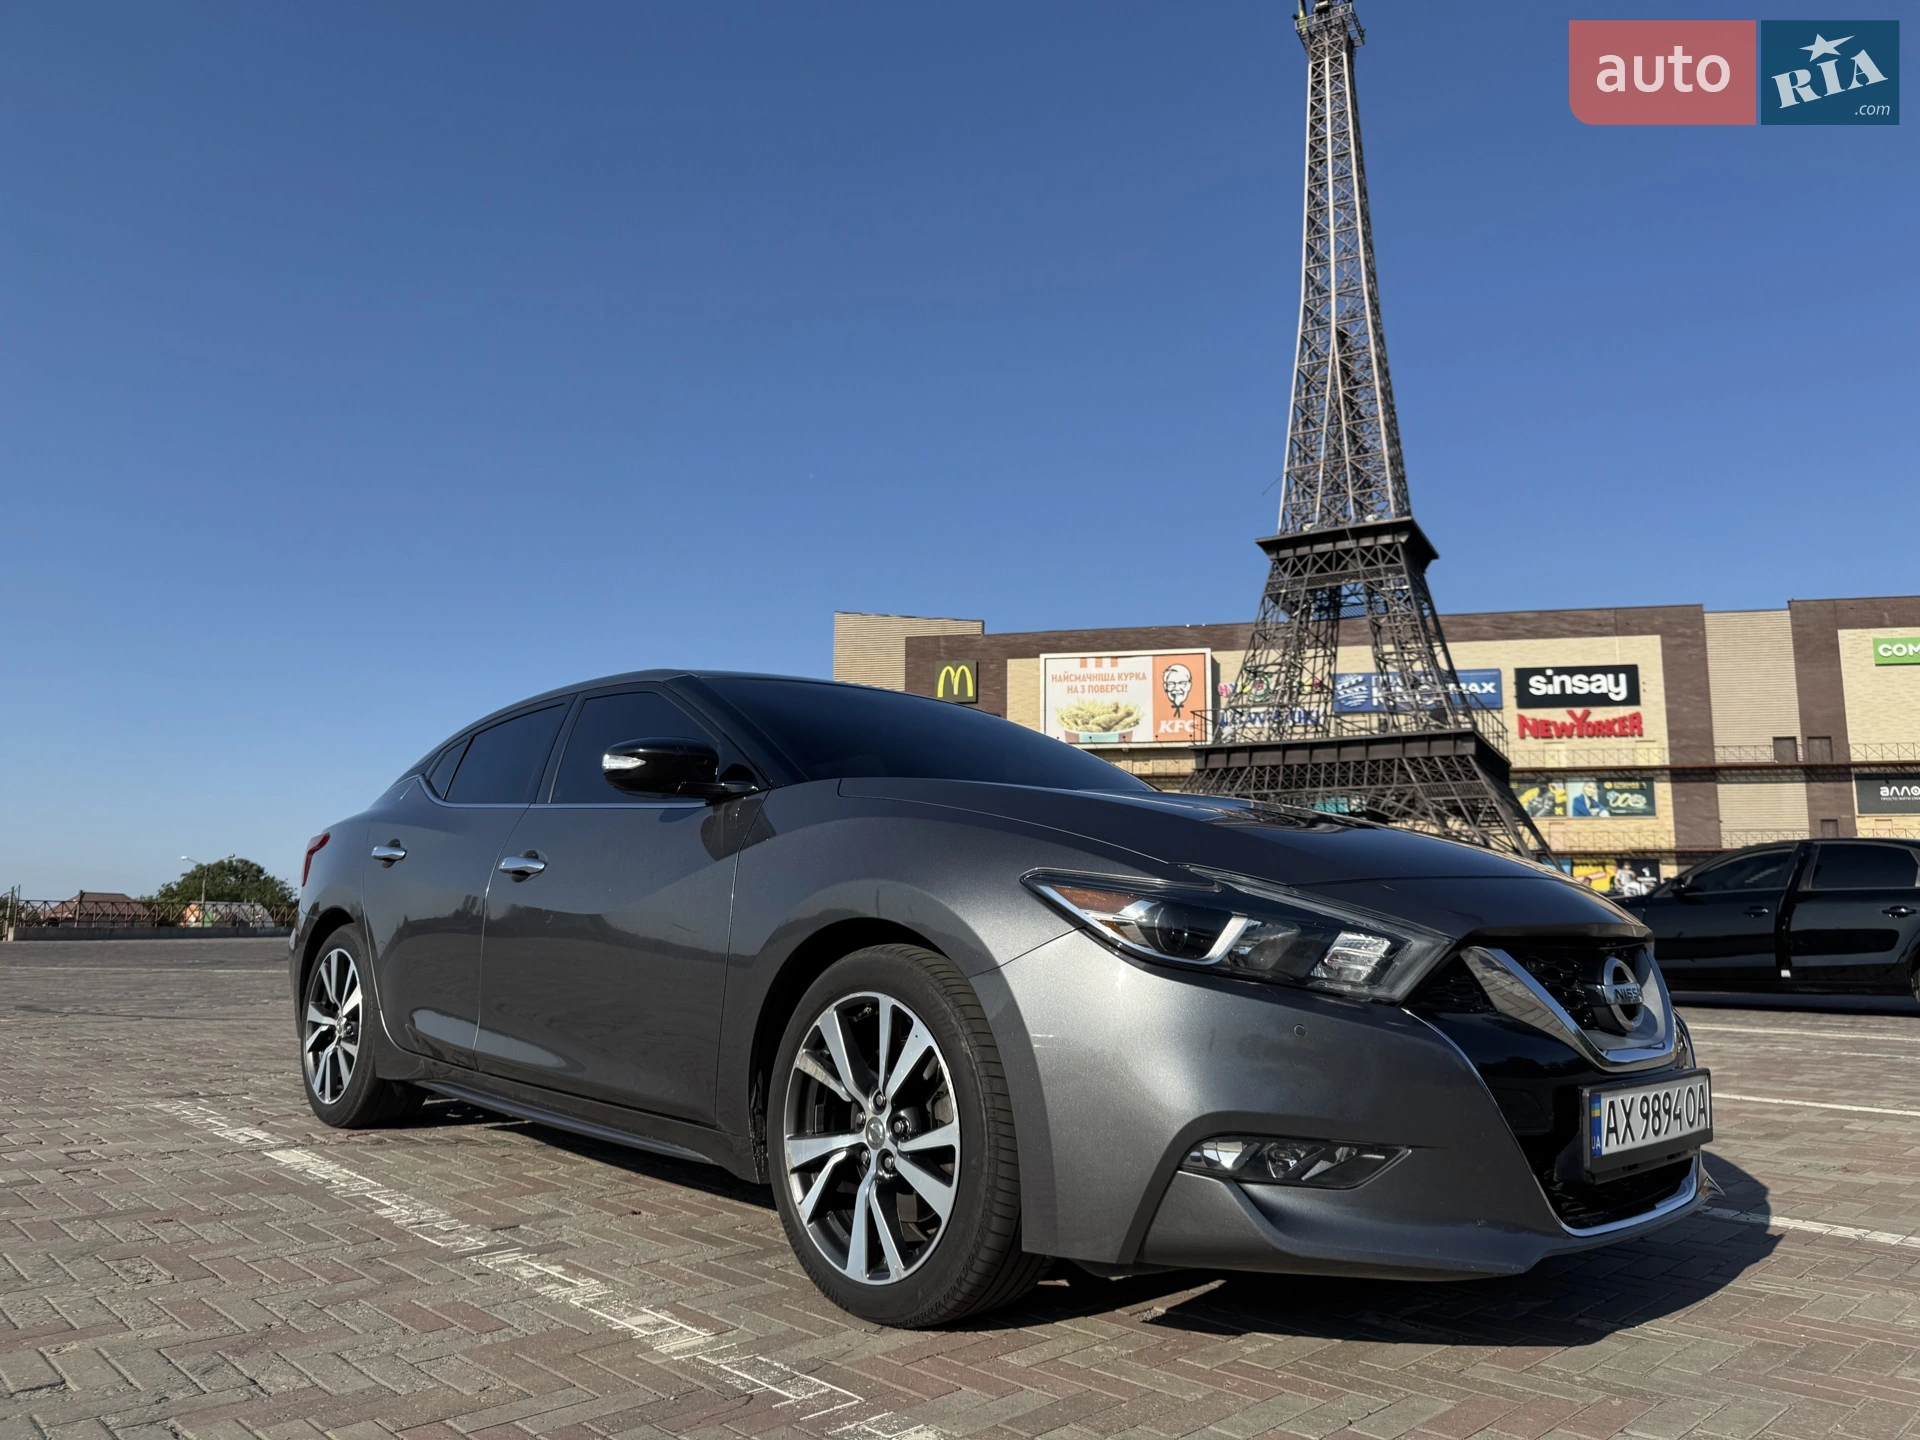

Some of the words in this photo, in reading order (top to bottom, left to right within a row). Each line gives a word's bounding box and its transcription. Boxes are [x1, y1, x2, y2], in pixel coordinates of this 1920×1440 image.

[1051, 670, 1116, 683] НАЙСМАЧНІША
[1117, 671, 1147, 682] КУРКА
[1067, 684, 1080, 694] НА
[1080, 684, 1086, 694] 3
[1087, 683, 1128, 694] ПОВЕРСІ!
[1445, 681, 1497, 696] MAX
[1528, 669, 1628, 701] sinsay
[1158, 719, 1199, 734] KFC
[1591, 1135, 1601, 1150] UA
